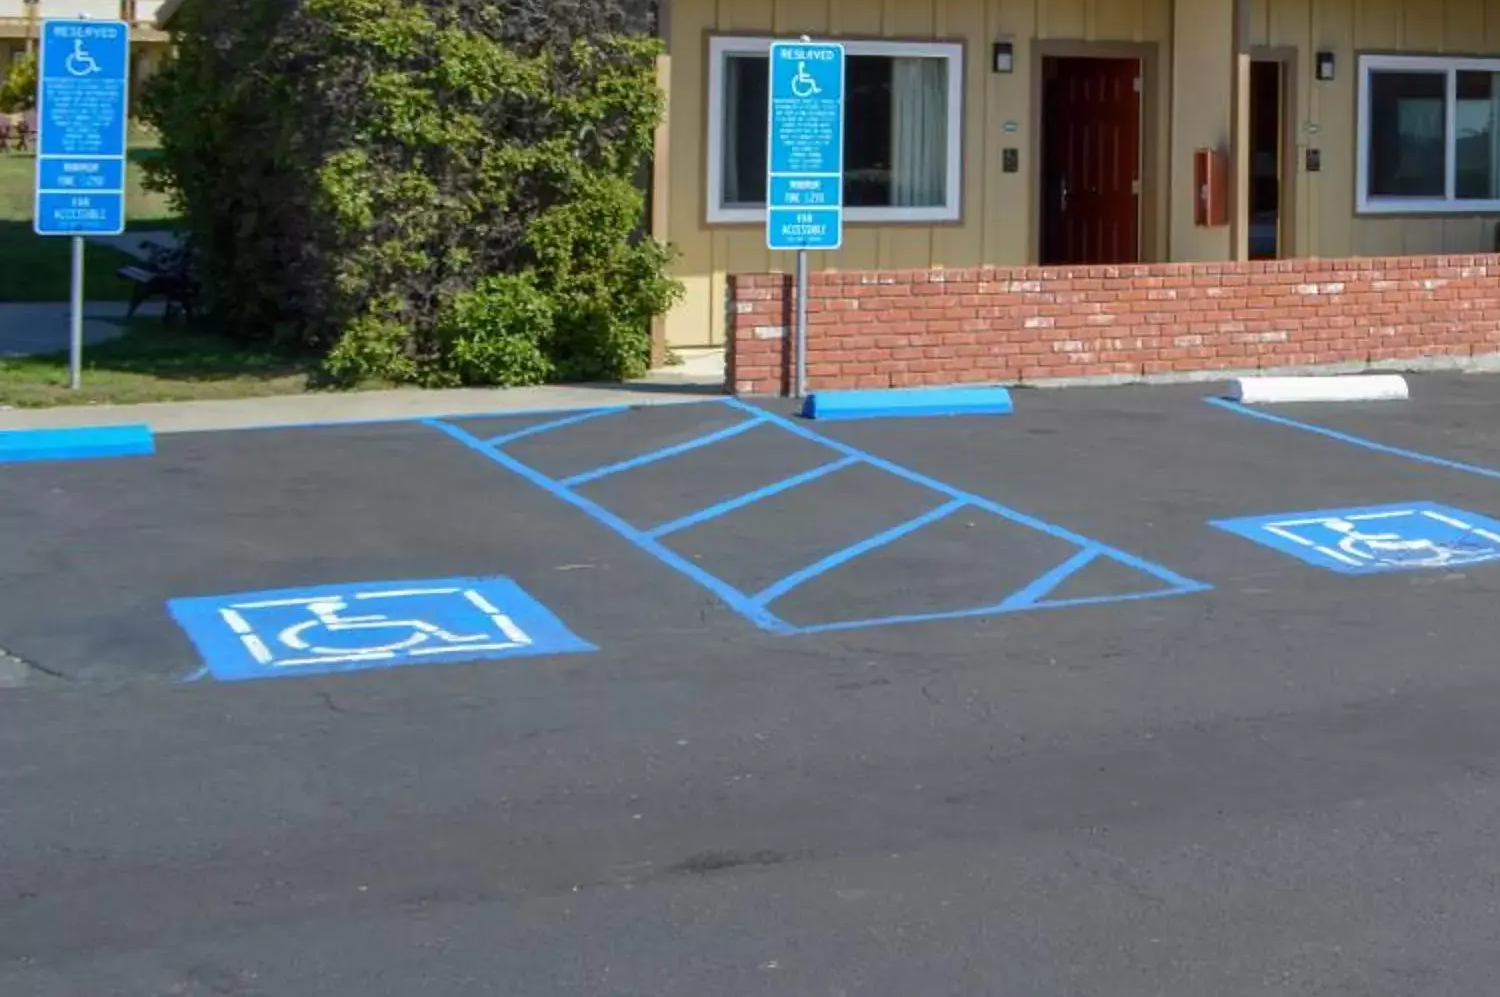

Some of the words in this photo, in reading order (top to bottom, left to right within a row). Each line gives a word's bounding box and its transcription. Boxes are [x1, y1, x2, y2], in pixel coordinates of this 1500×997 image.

[53, 27, 118, 38] RESERVED
[781, 49, 834, 60] RESERVED
[781, 224, 827, 236] ACSSLE
